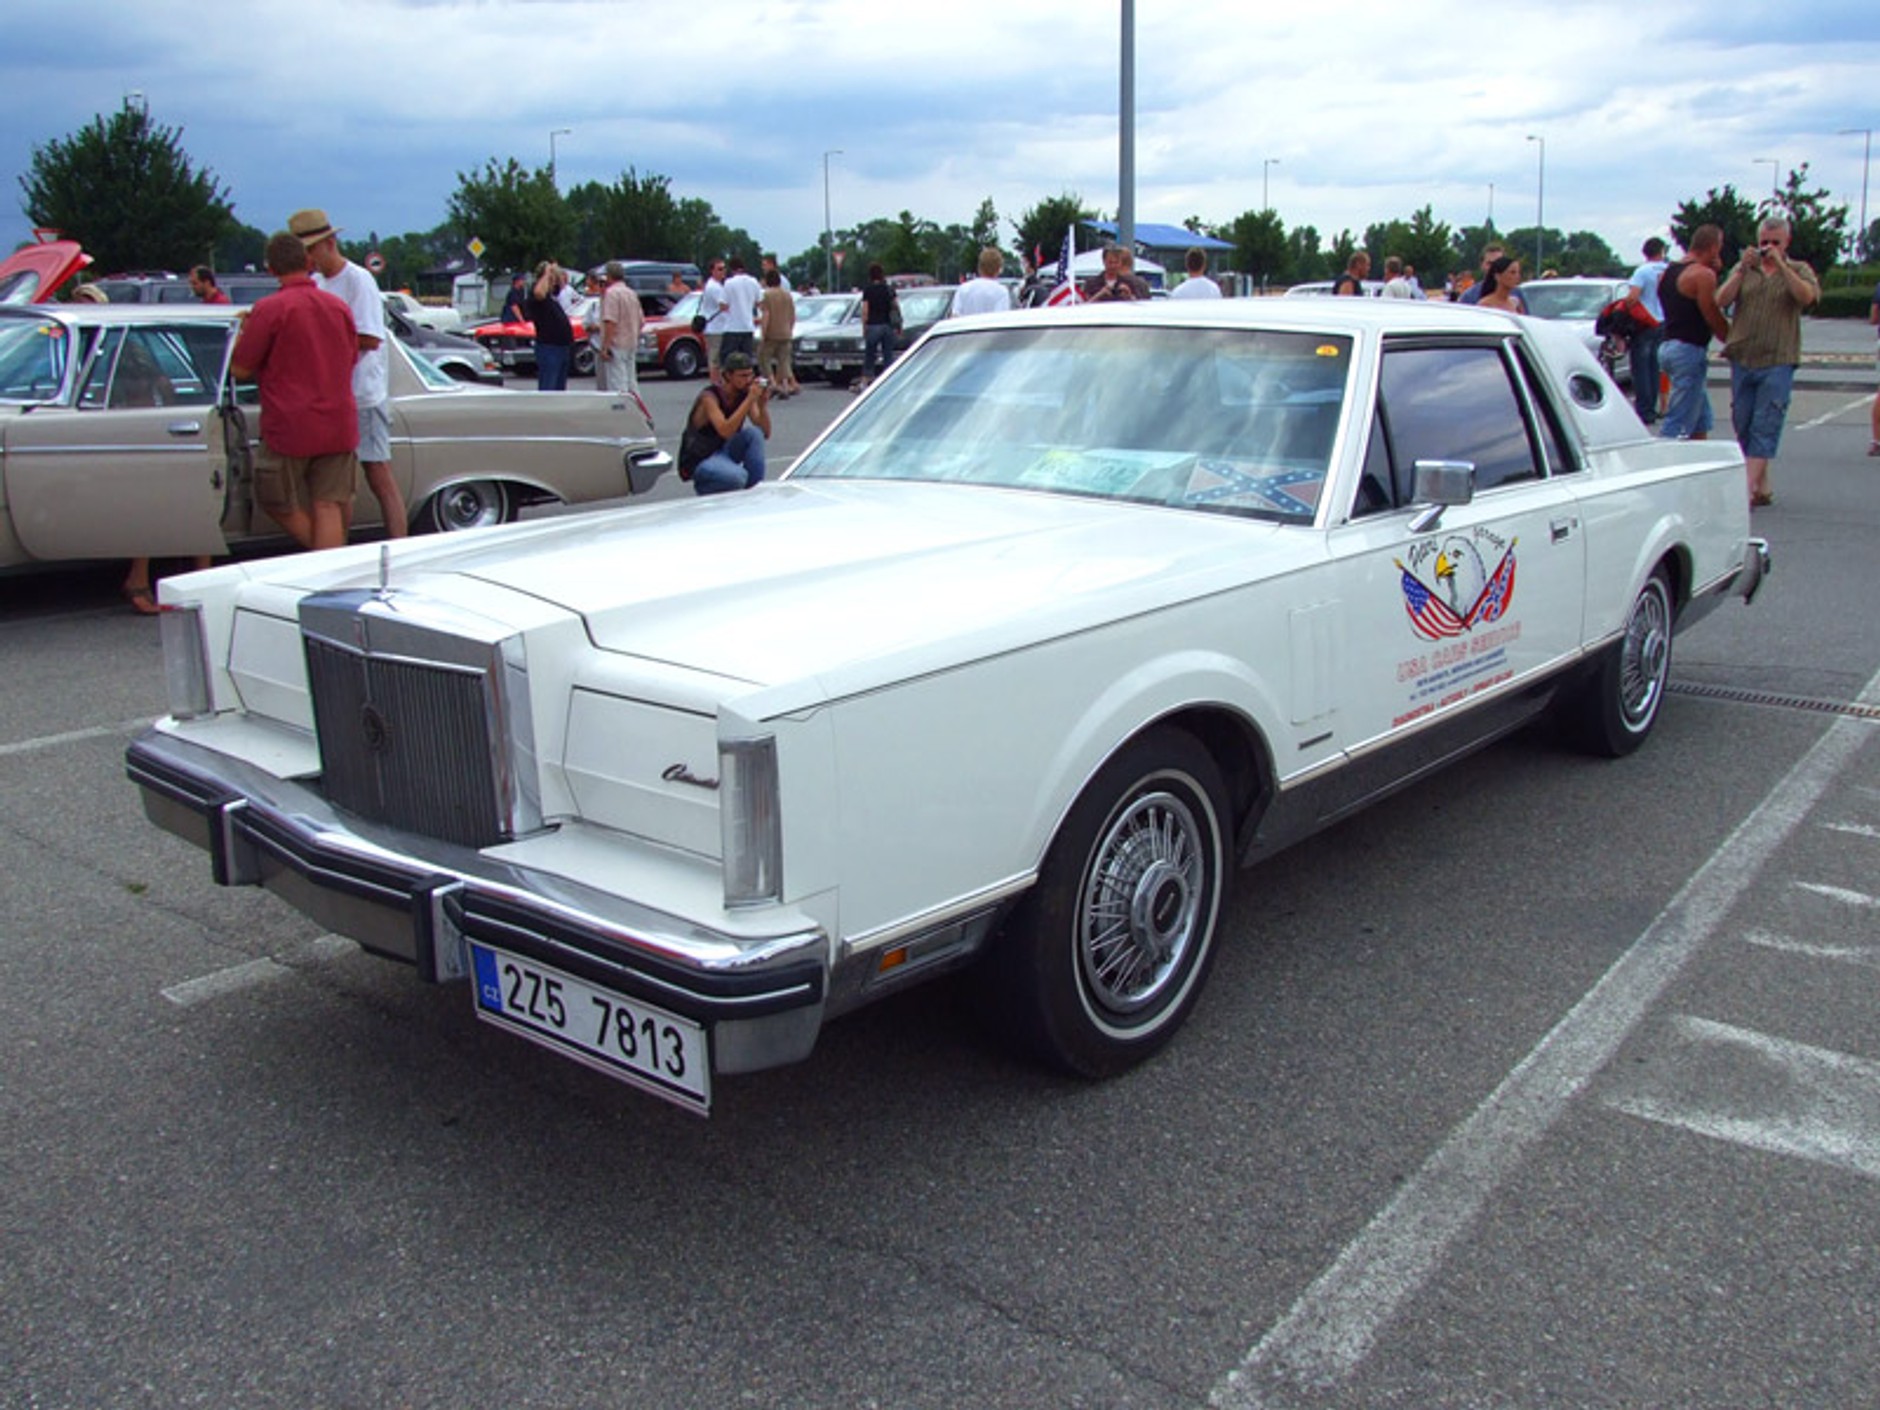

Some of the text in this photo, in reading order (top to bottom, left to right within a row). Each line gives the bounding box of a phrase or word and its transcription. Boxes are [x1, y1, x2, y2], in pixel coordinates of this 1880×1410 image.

[1397, 656, 1428, 683] USA
[1432, 641, 1467, 670] CARS
[483, 984, 500, 1002] CZ
[503, 963, 686, 1078] 2Z5 7813
